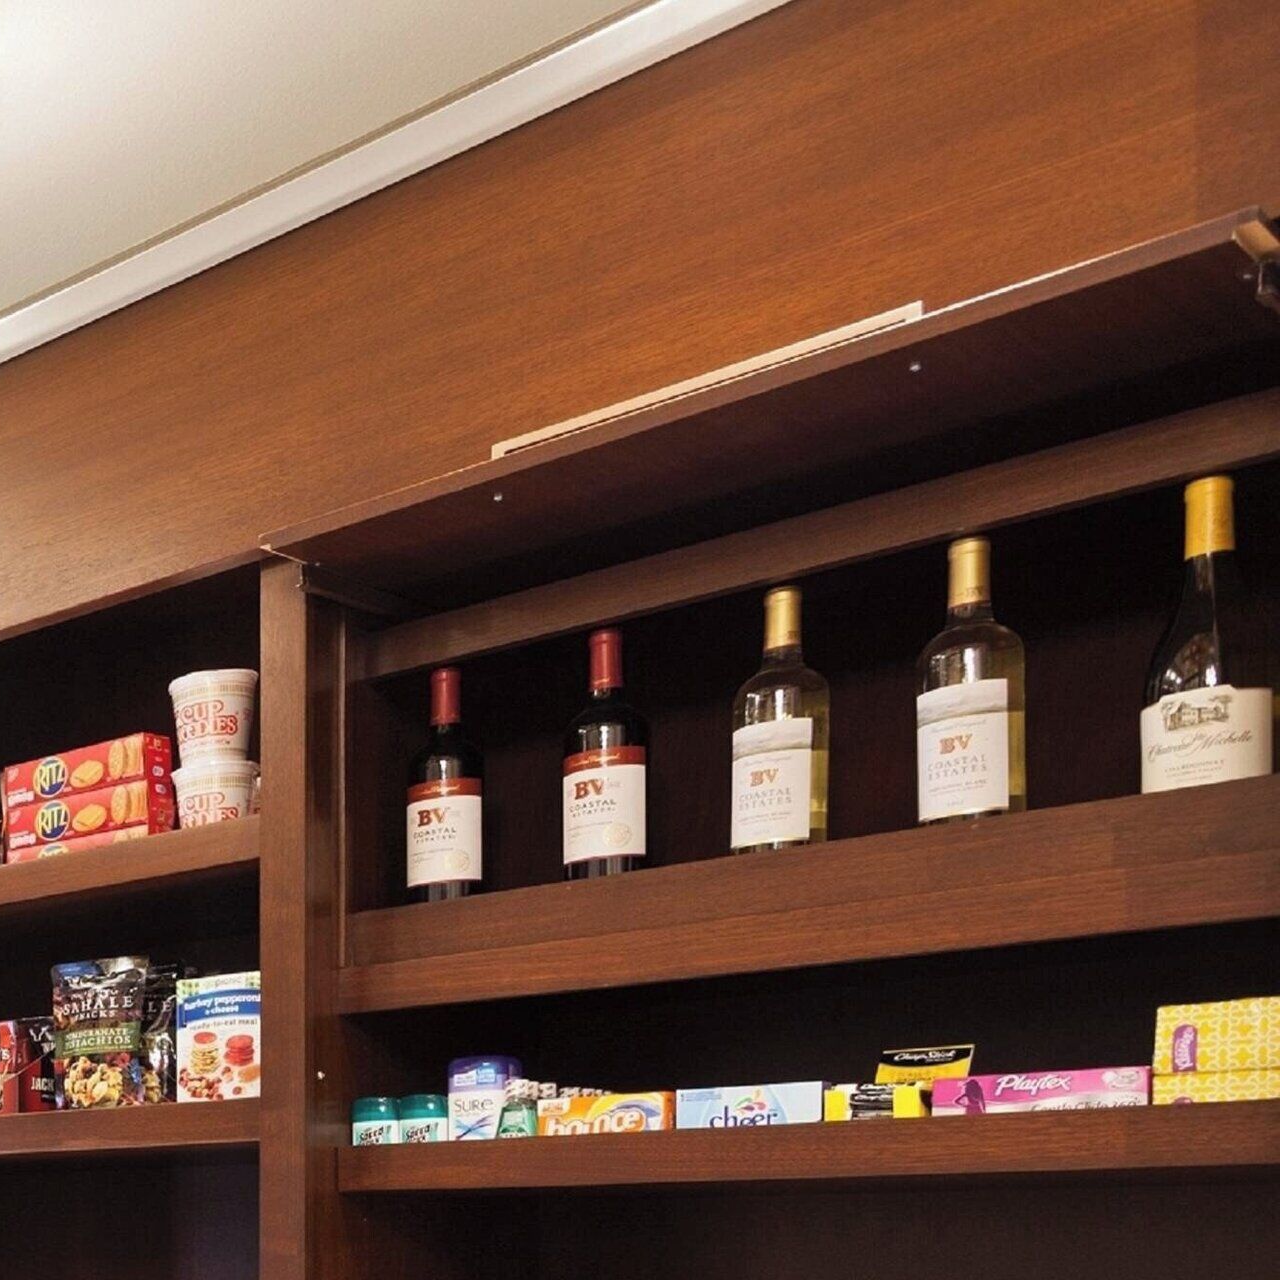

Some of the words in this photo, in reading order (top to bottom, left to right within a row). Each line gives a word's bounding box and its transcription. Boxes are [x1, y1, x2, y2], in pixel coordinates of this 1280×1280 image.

[178, 700, 224, 723] CUP
[939, 733, 973, 755] BV
[35, 761, 68, 792] RITZ
[750, 768, 779, 787] BV
[575, 779, 604, 800] BV
[569, 799, 617, 813] COASTAL
[37, 805, 70, 835] RITZ
[417, 809, 446, 827] BV
[413, 828, 457, 840] COASTAL
[63, 994, 134, 1017] SAHALE
[184, 997, 213, 1012] turkey
[210, 1005, 239, 1015] cheese
[238, 1018, 258, 1026] meal
[894, 1049, 957, 1062] ChapStick
[1176, 1025, 1194, 1069] Kleenex
[994, 1073, 1072, 1096] Playtex
[545, 1108, 644, 1136] bounce
[710, 1106, 778, 1128] cheer
